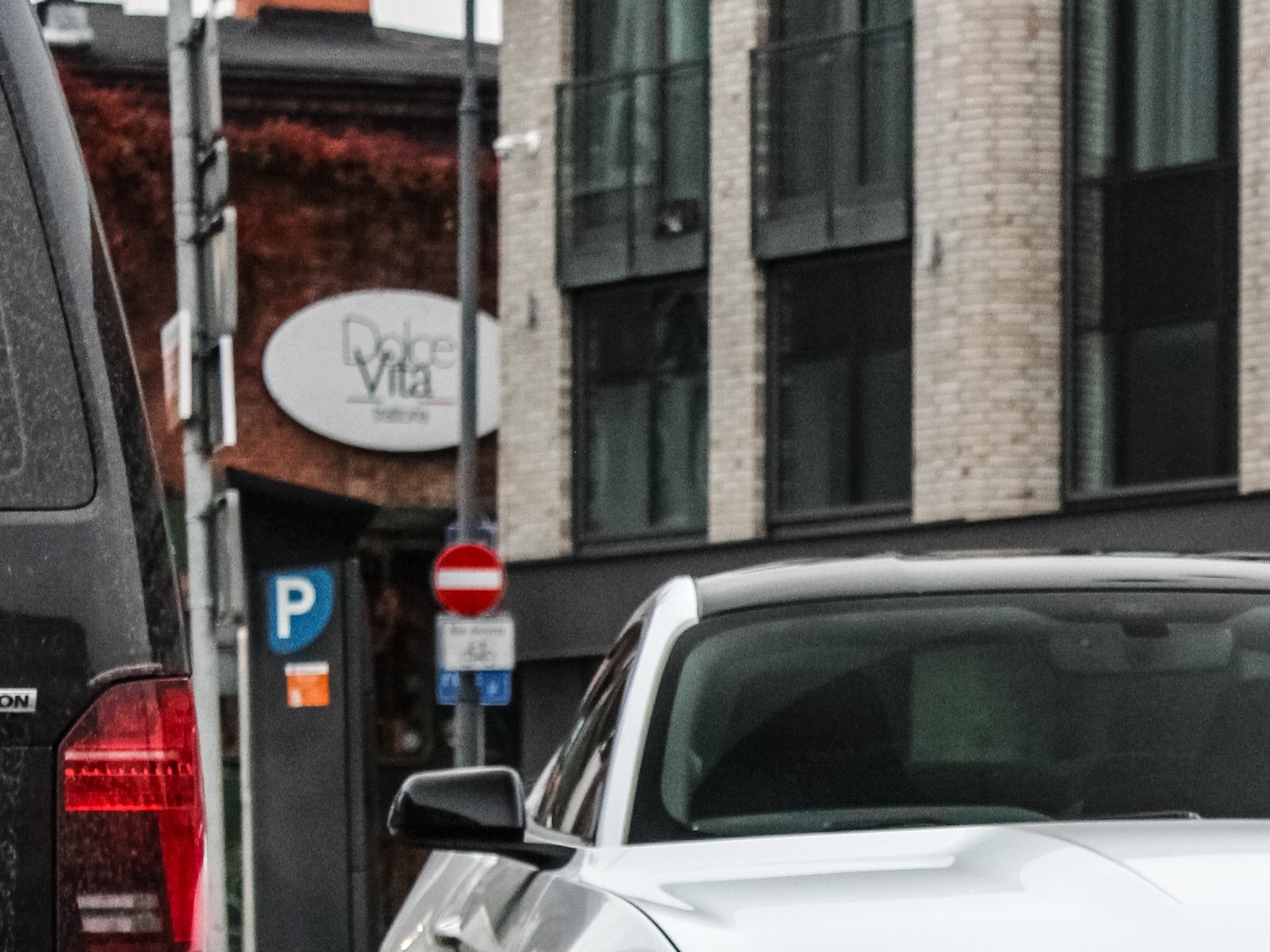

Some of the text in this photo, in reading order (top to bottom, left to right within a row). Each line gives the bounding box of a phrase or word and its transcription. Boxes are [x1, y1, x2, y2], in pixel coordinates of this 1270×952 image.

[341, 314, 457, 369] Dolce
[353, 346, 433, 399] Vita
[275, 576, 317, 640] P
